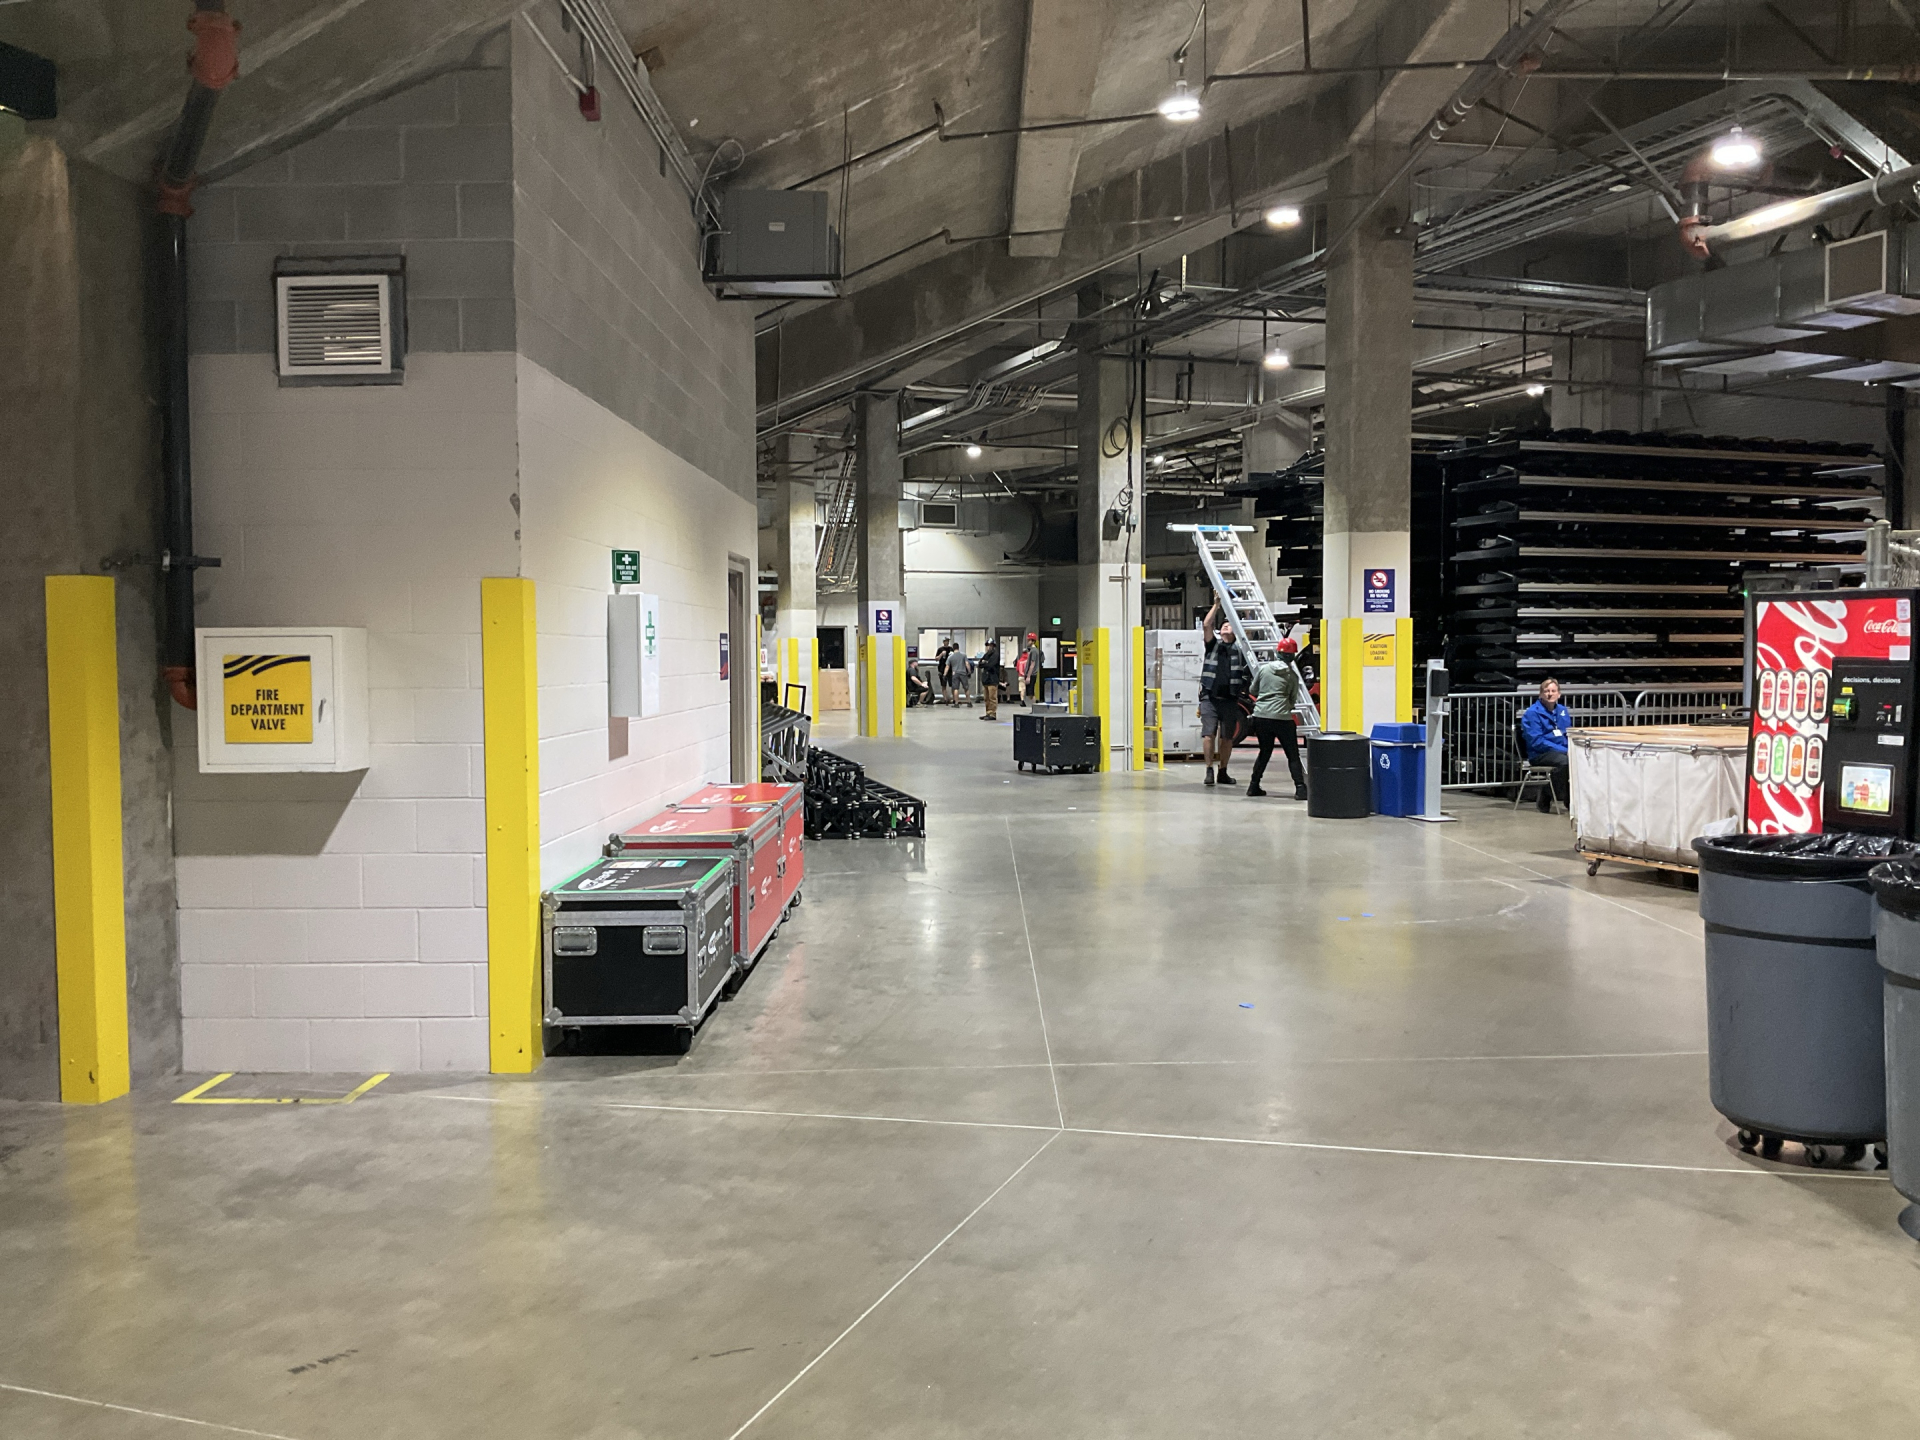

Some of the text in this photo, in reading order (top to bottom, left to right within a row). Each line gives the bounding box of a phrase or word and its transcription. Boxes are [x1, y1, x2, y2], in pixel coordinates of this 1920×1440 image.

[1842, 676, 1901, 684] decisions, decisions
[256, 689, 279, 700] FIRE
[231, 704, 304, 716] DEPARTMENT
[251, 718, 286, 730] VALVE
